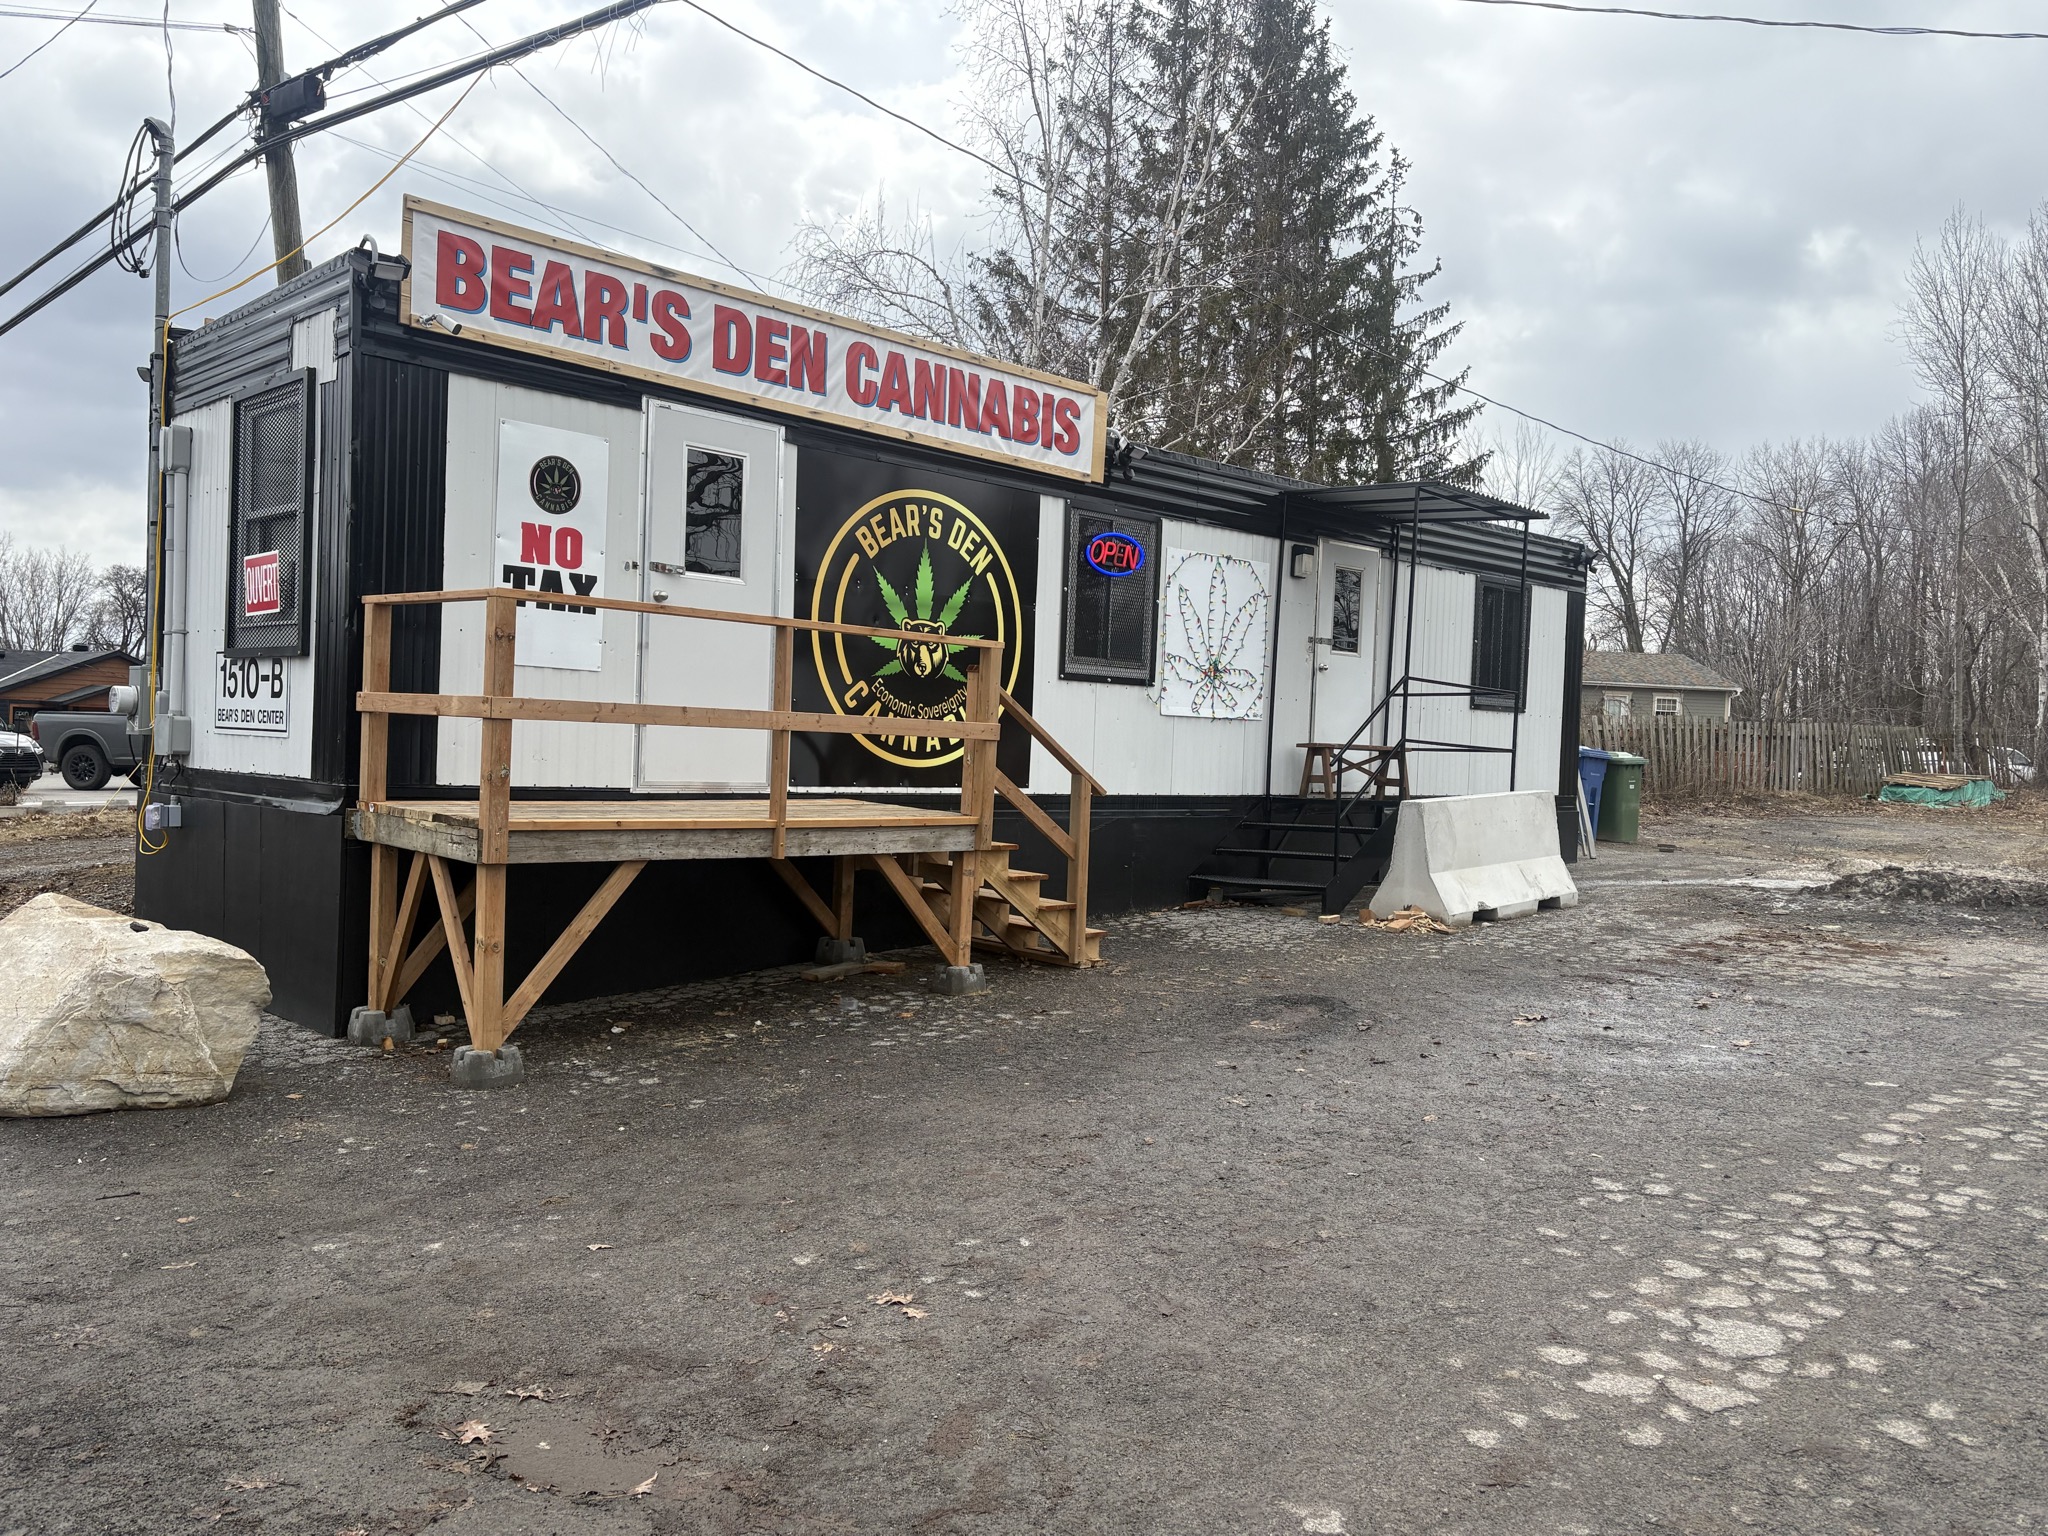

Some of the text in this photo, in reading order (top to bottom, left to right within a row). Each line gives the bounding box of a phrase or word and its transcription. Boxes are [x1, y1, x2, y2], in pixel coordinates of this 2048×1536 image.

[435, 229, 1081, 455] BEAR'S DEN CANNABIS
[520, 521, 583, 570] NO
[855, 504, 993, 576] BEAR'S DEN
[1091, 540, 1139, 569] OPEN
[246, 564, 278, 604] OUVERT
[502, 564, 598, 615] TAX
[220, 657, 283, 699] 1510-B
[871, 677, 916, 719] Economic
[217, 708, 284, 725] BEAR'S DEN CENTER
